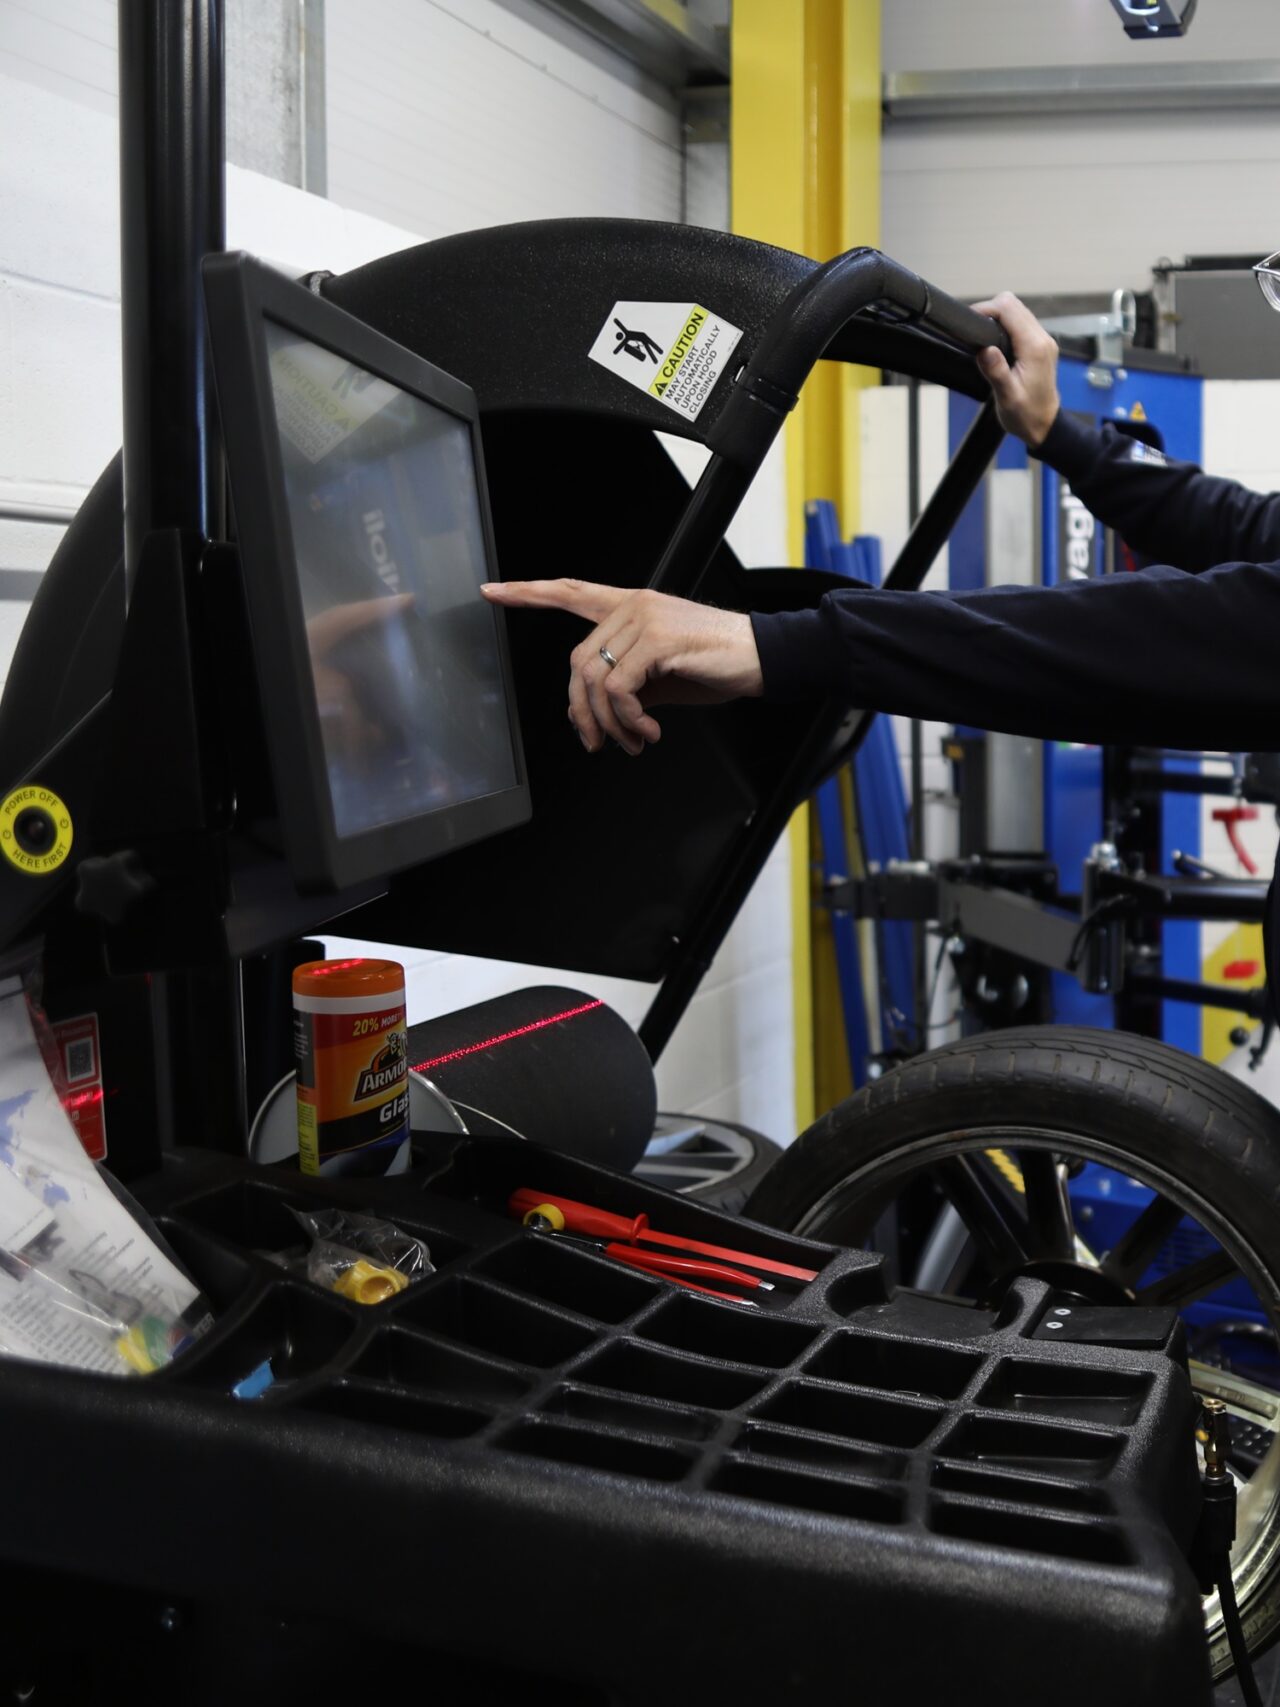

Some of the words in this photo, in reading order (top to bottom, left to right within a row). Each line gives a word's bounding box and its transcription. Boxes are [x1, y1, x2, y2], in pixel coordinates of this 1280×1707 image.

[662, 312, 704, 378] CAUTION
[673, 325, 721, 404] AUTOMATICALLY
[665, 376, 681, 400] MAY
[679, 346, 699, 377] START
[681, 377, 701, 409] UPON
[698, 350, 717, 381] HOOD
[688, 371, 717, 414] CLOSING
[4, 790, 36, 815] POWER
[38, 791, 59, 807] OFF
[12, 848, 41, 868] HERE
[43, 842, 67, 867] FIRST
[352, 1016, 379, 1037] 20%
